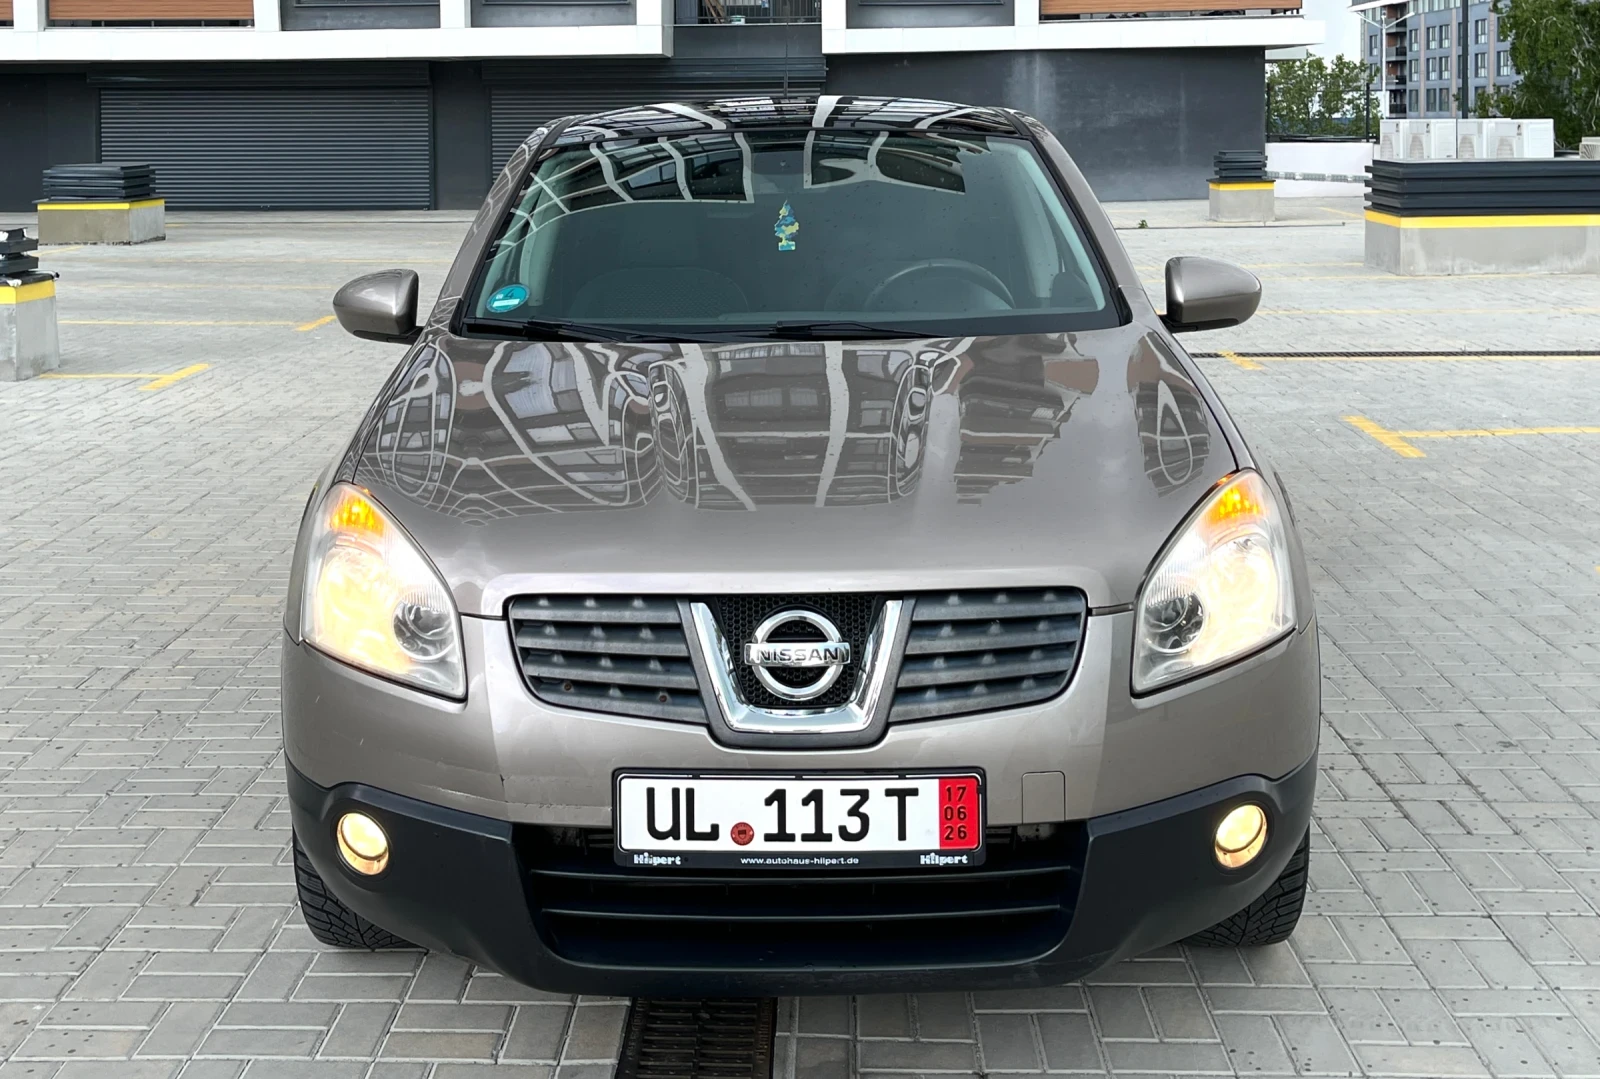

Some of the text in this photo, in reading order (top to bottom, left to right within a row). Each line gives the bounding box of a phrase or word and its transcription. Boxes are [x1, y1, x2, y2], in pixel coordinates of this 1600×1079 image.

[756, 646, 839, 662] NISSAN
[945, 785, 967, 802] 17
[646, 787, 720, 841] UL
[944, 805, 967, 821] 06
[944, 824, 967, 841] 26
[633, 852, 682, 866] Hilpert
[740, 856, 859, 867] www.autohaus-hilpert.de
[919, 852, 968, 866] Hilpert
